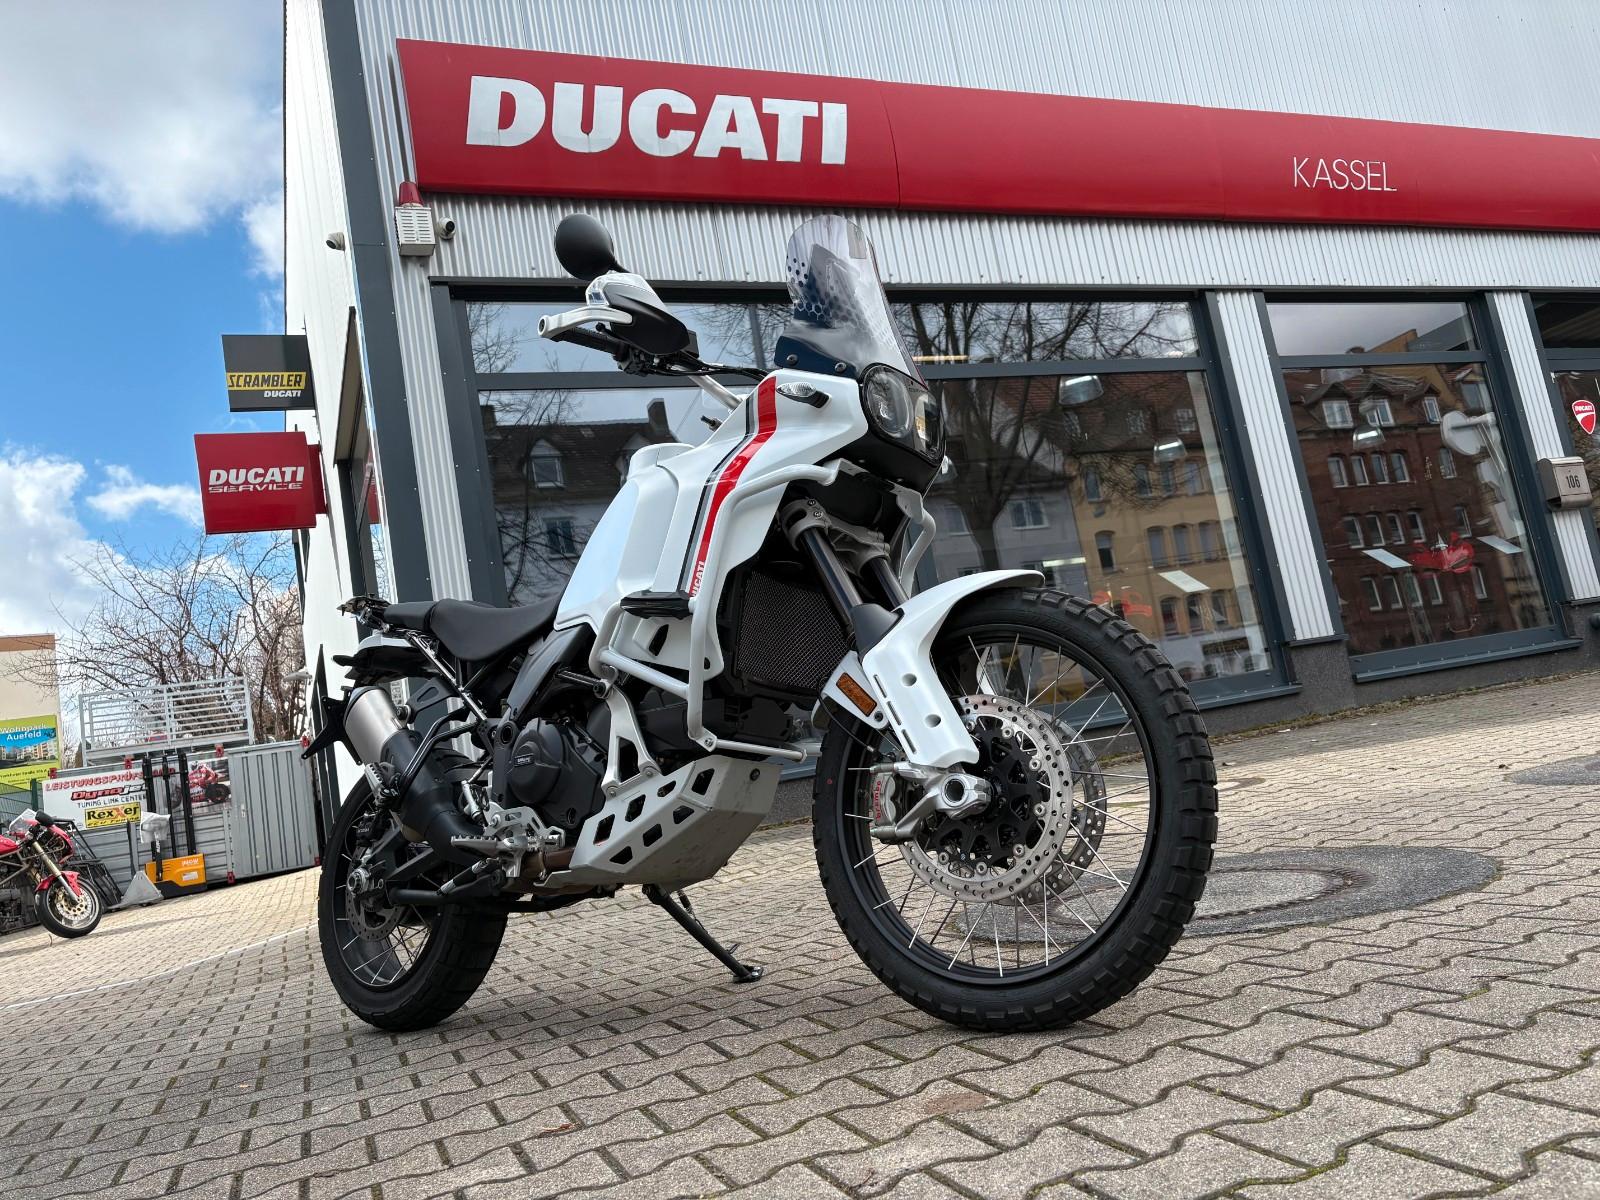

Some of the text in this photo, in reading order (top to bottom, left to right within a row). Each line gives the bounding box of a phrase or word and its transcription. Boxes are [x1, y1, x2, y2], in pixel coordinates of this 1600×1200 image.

[466, 75, 848, 165] DUCATI
[1293, 156, 1398, 192] KASSEL
[228, 374, 302, 388] SCRAMBLER
[264, 390, 301, 398] DUCATI
[209, 466, 305, 486] DUCATI
[1566, 475, 1581, 489] 106
[208, 482, 303, 494] SERVICE
[7, 731, 42, 742] Auefeld
[77, 799, 101, 808] TUNING
[103, 797, 119, 806] LINK
